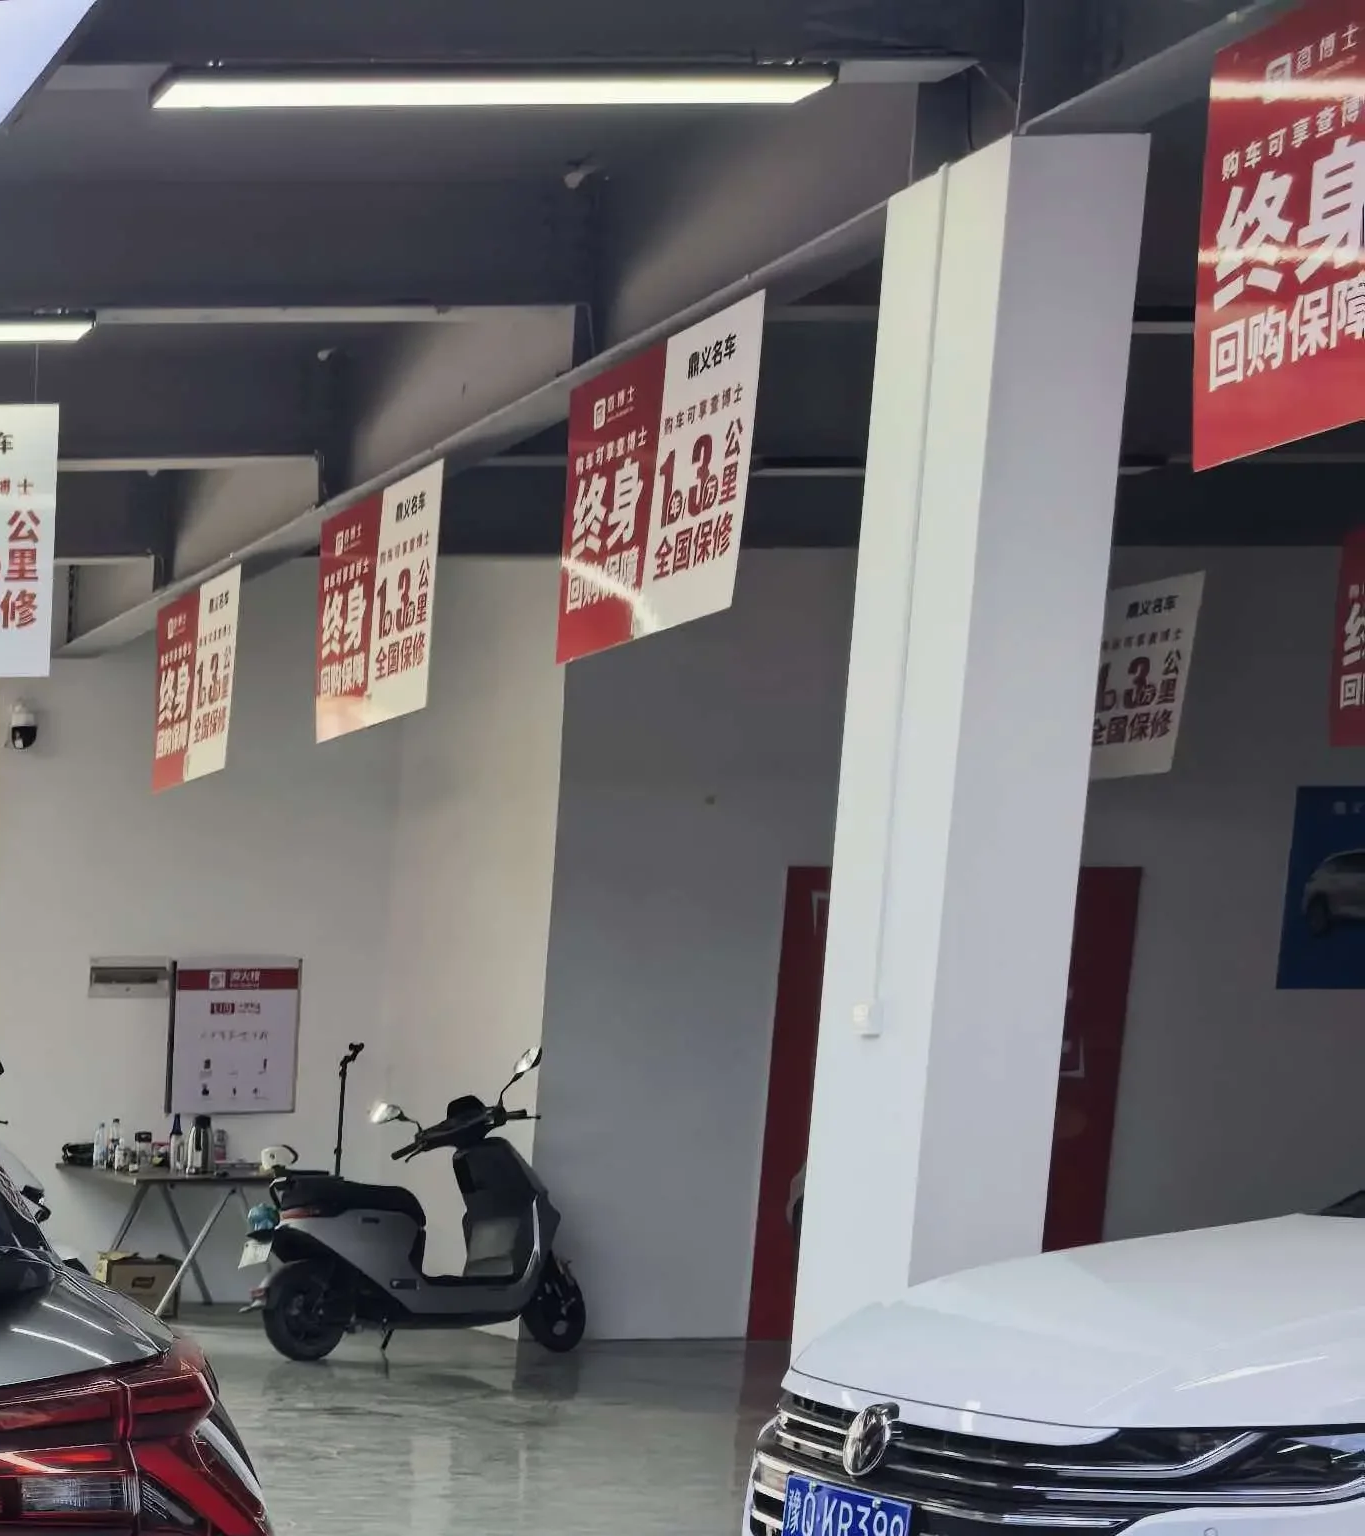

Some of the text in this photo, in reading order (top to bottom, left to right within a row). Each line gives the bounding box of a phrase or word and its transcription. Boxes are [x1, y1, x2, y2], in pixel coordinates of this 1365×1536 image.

[1213, 134, 1365, 312] 终身
[687, 333, 737, 380] 鼎义名车
[1209, 272, 1365, 392] 回购保障
[570, 456, 644, 558] 终身
[653, 511, 733, 582] 全国保修
[321, 580, 366, 660] 终身
[375, 631, 425, 681] 全国保修
[158, 660, 191, 726] 终身
